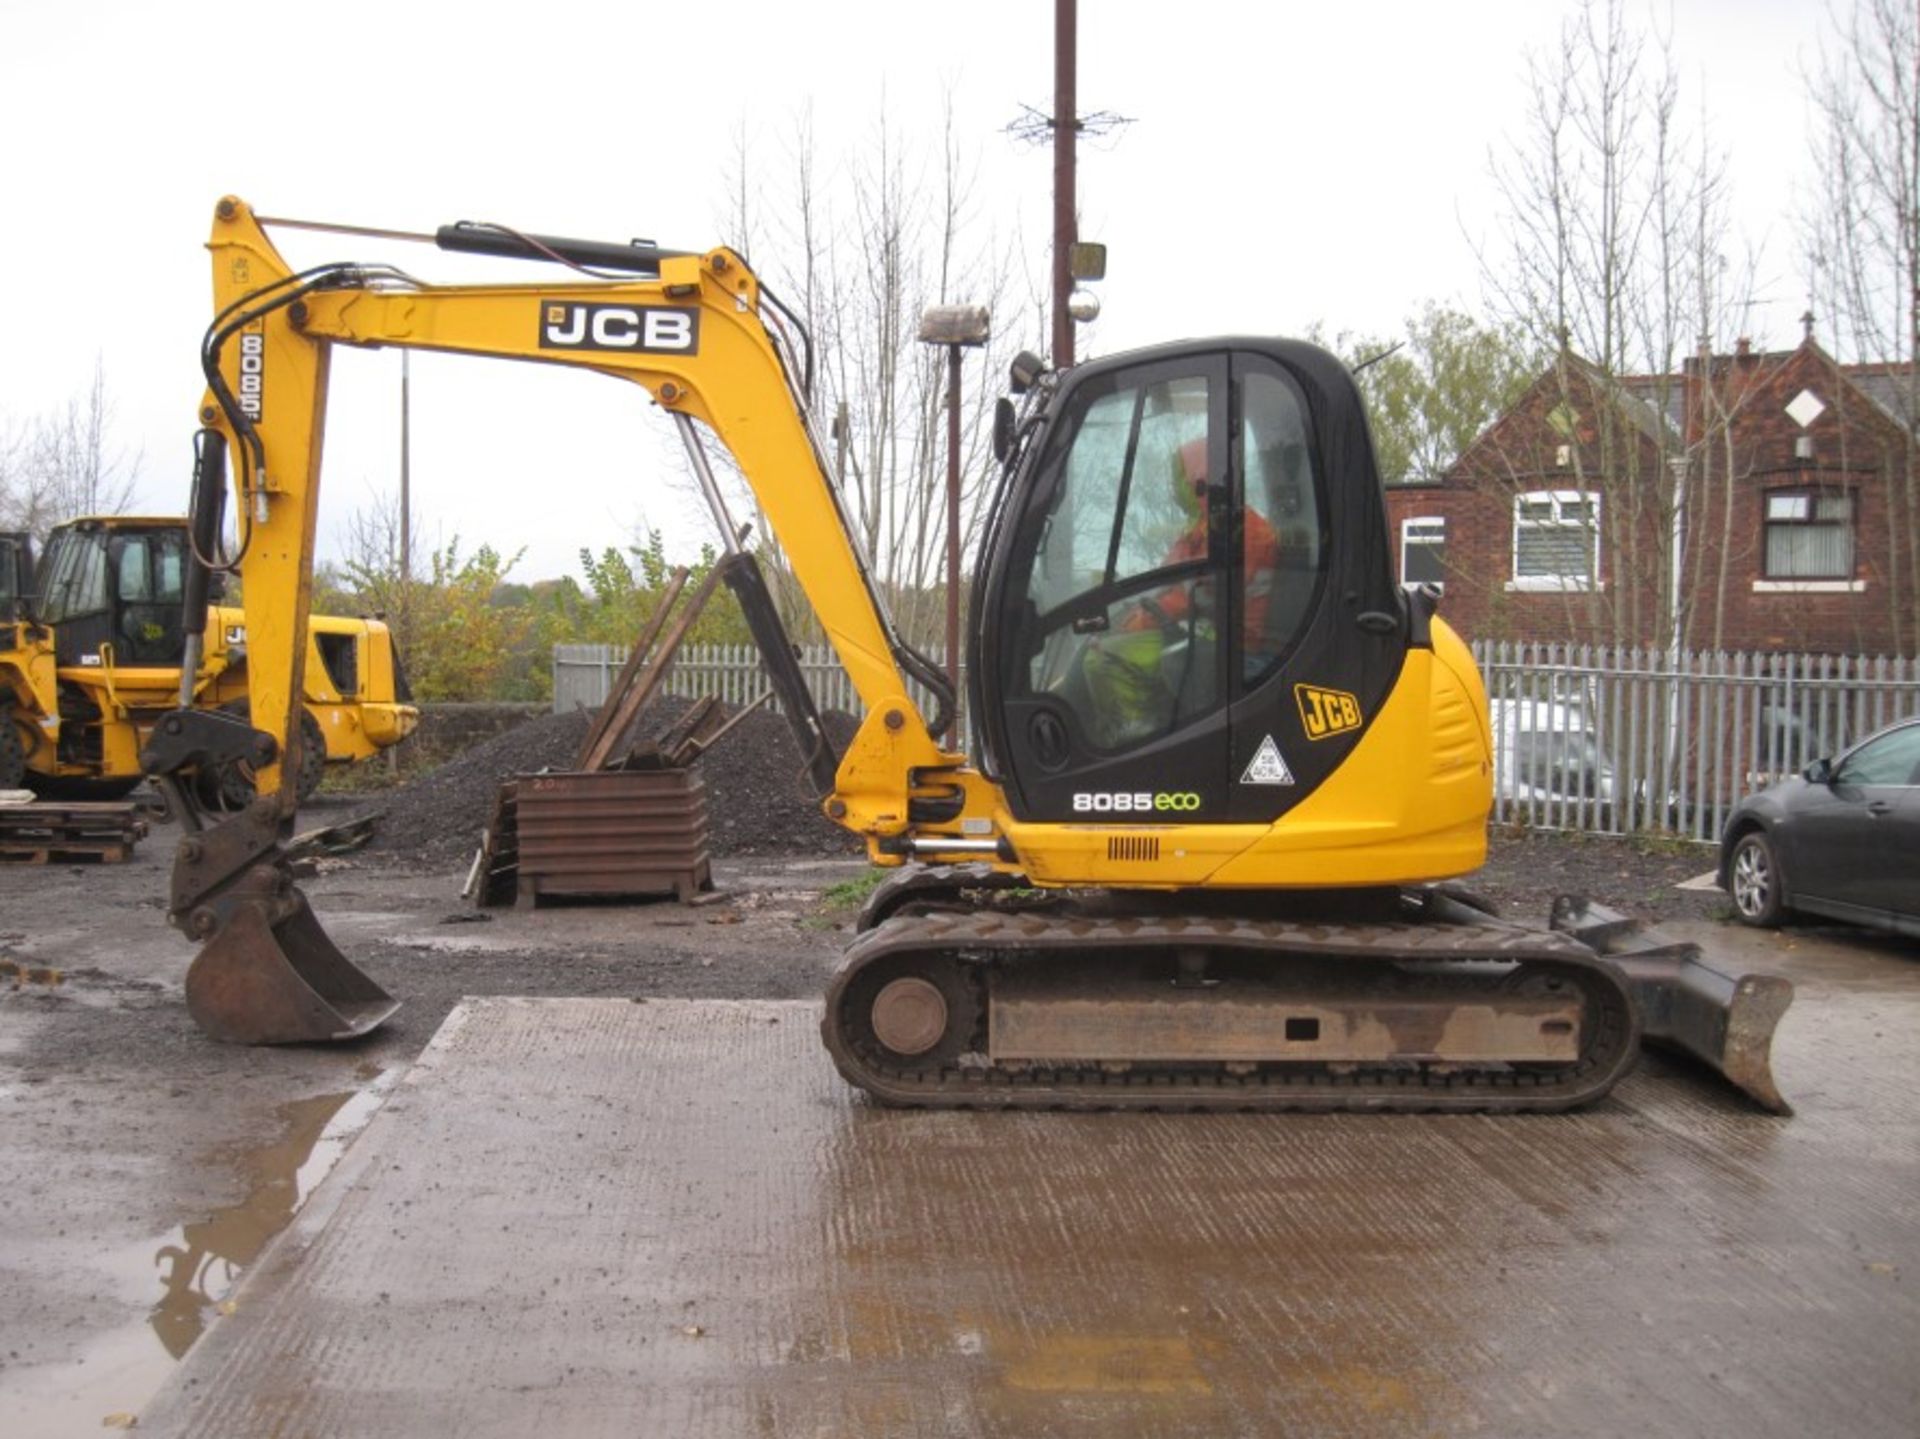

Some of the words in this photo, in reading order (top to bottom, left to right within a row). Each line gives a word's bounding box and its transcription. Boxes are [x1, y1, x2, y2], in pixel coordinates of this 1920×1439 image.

[547, 307, 692, 349] JCB
[242, 334, 262, 412] 8085
[1307, 690, 1358, 734] JCB
